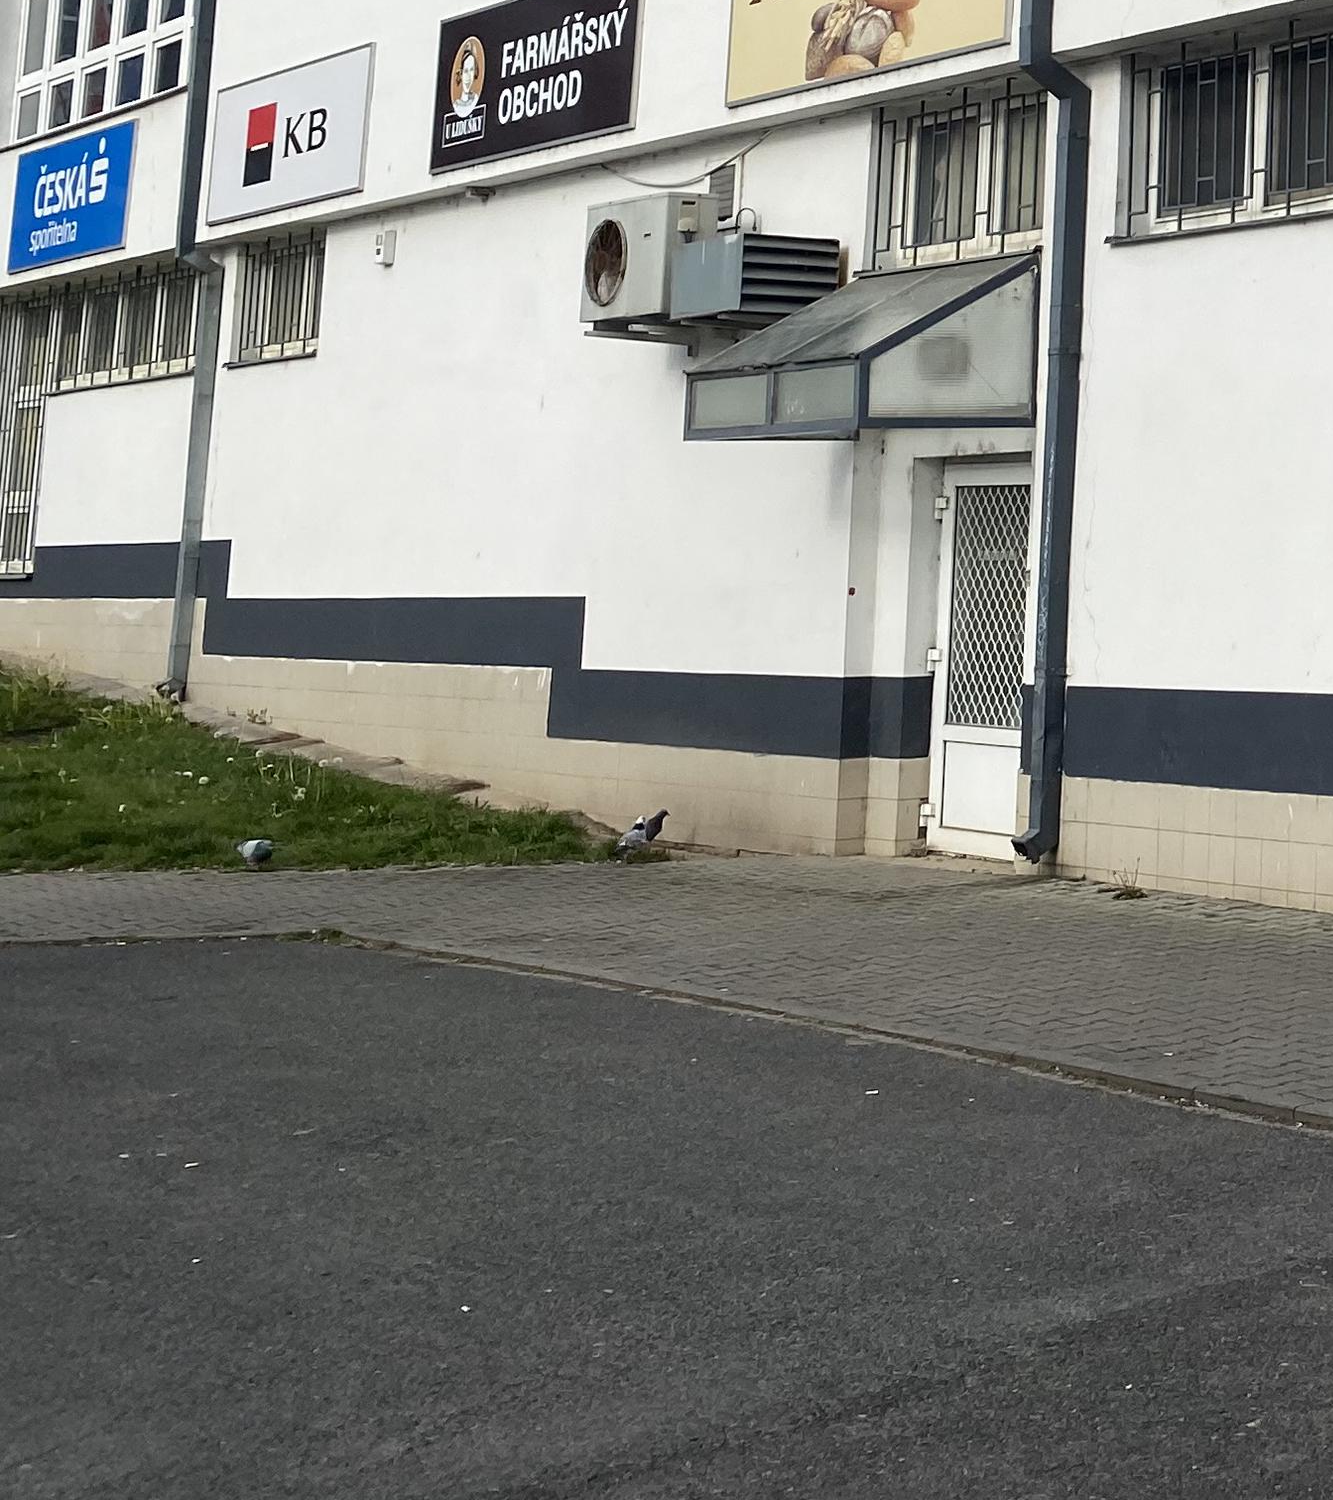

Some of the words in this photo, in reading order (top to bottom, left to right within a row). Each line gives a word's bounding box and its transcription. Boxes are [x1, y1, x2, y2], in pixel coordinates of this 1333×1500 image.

[498, 69, 583, 125] OBCHOD
[282, 107, 328, 158] KB
[34, 151, 89, 219] ČESKÁ
[28, 217, 78, 257] spořitelna
